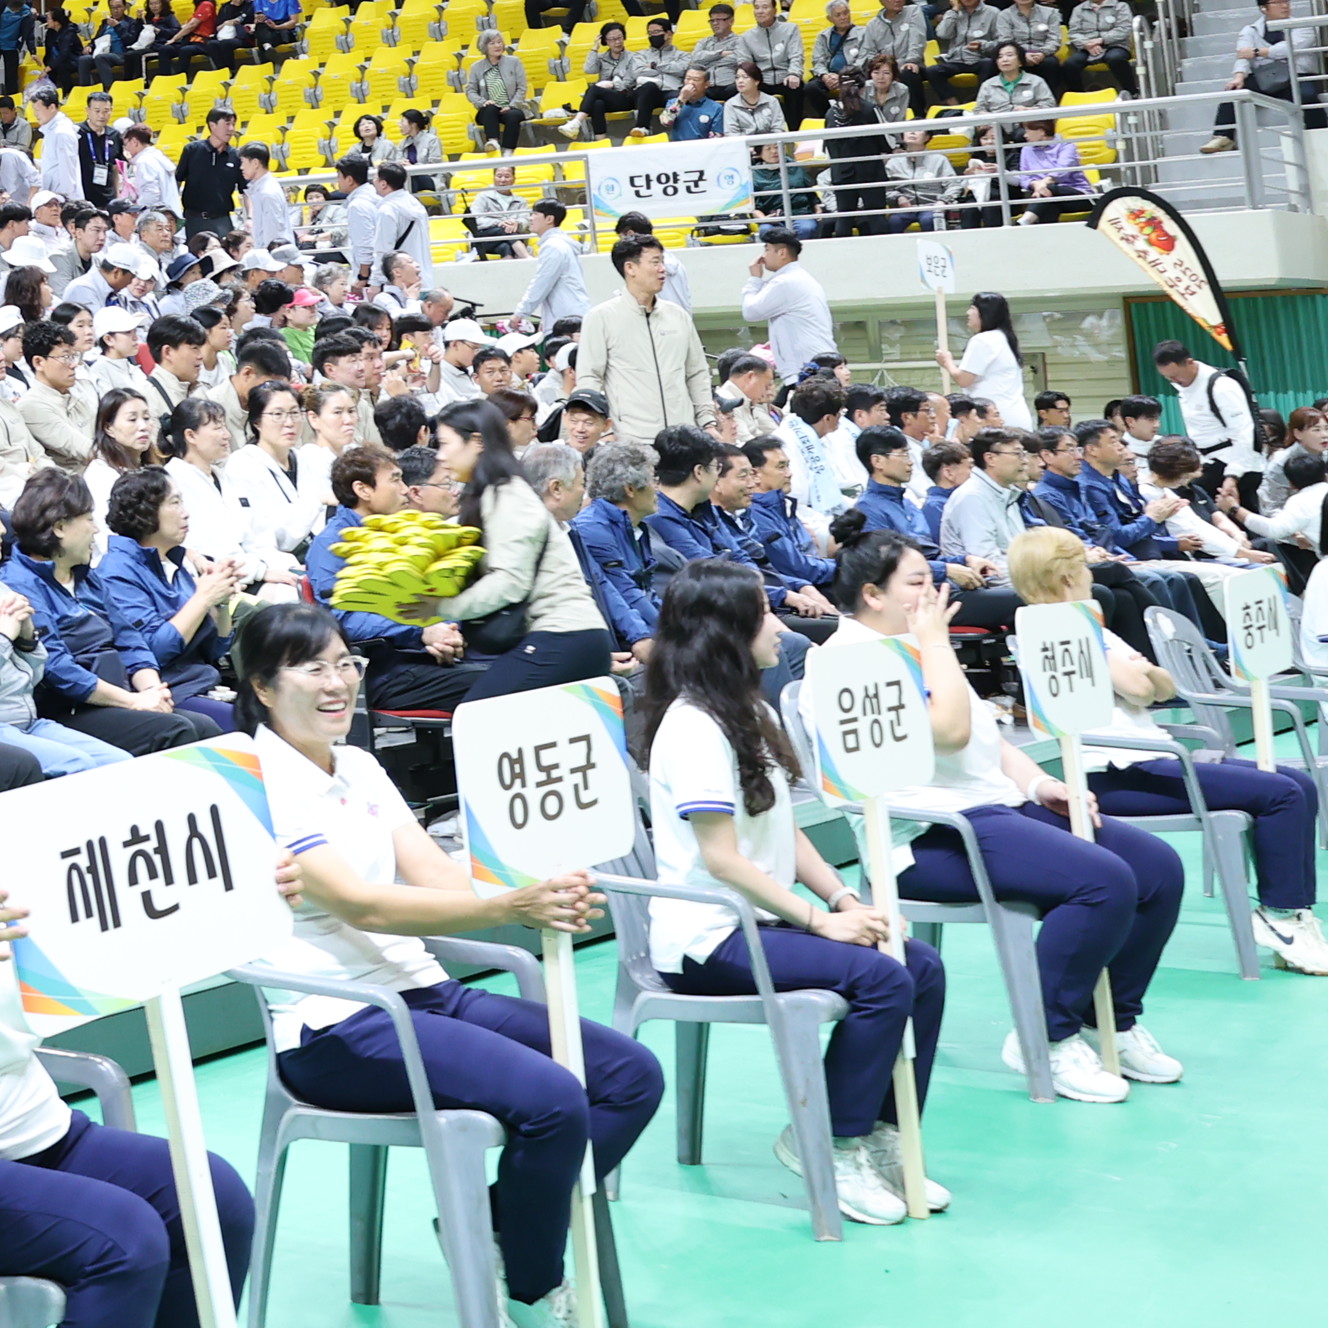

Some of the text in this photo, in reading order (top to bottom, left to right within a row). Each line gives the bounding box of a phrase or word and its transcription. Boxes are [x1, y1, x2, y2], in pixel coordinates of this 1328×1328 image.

[629, 169, 707, 198] 단양군
[926, 254, 948, 278] 보은군
[1242, 594, 1280, 650] 충주시
[1040, 636, 1095, 698] 청주시
[838, 680, 908, 753] 음성군
[497, 733, 599, 830] 영동군
[60, 803, 234, 932] 제천시
